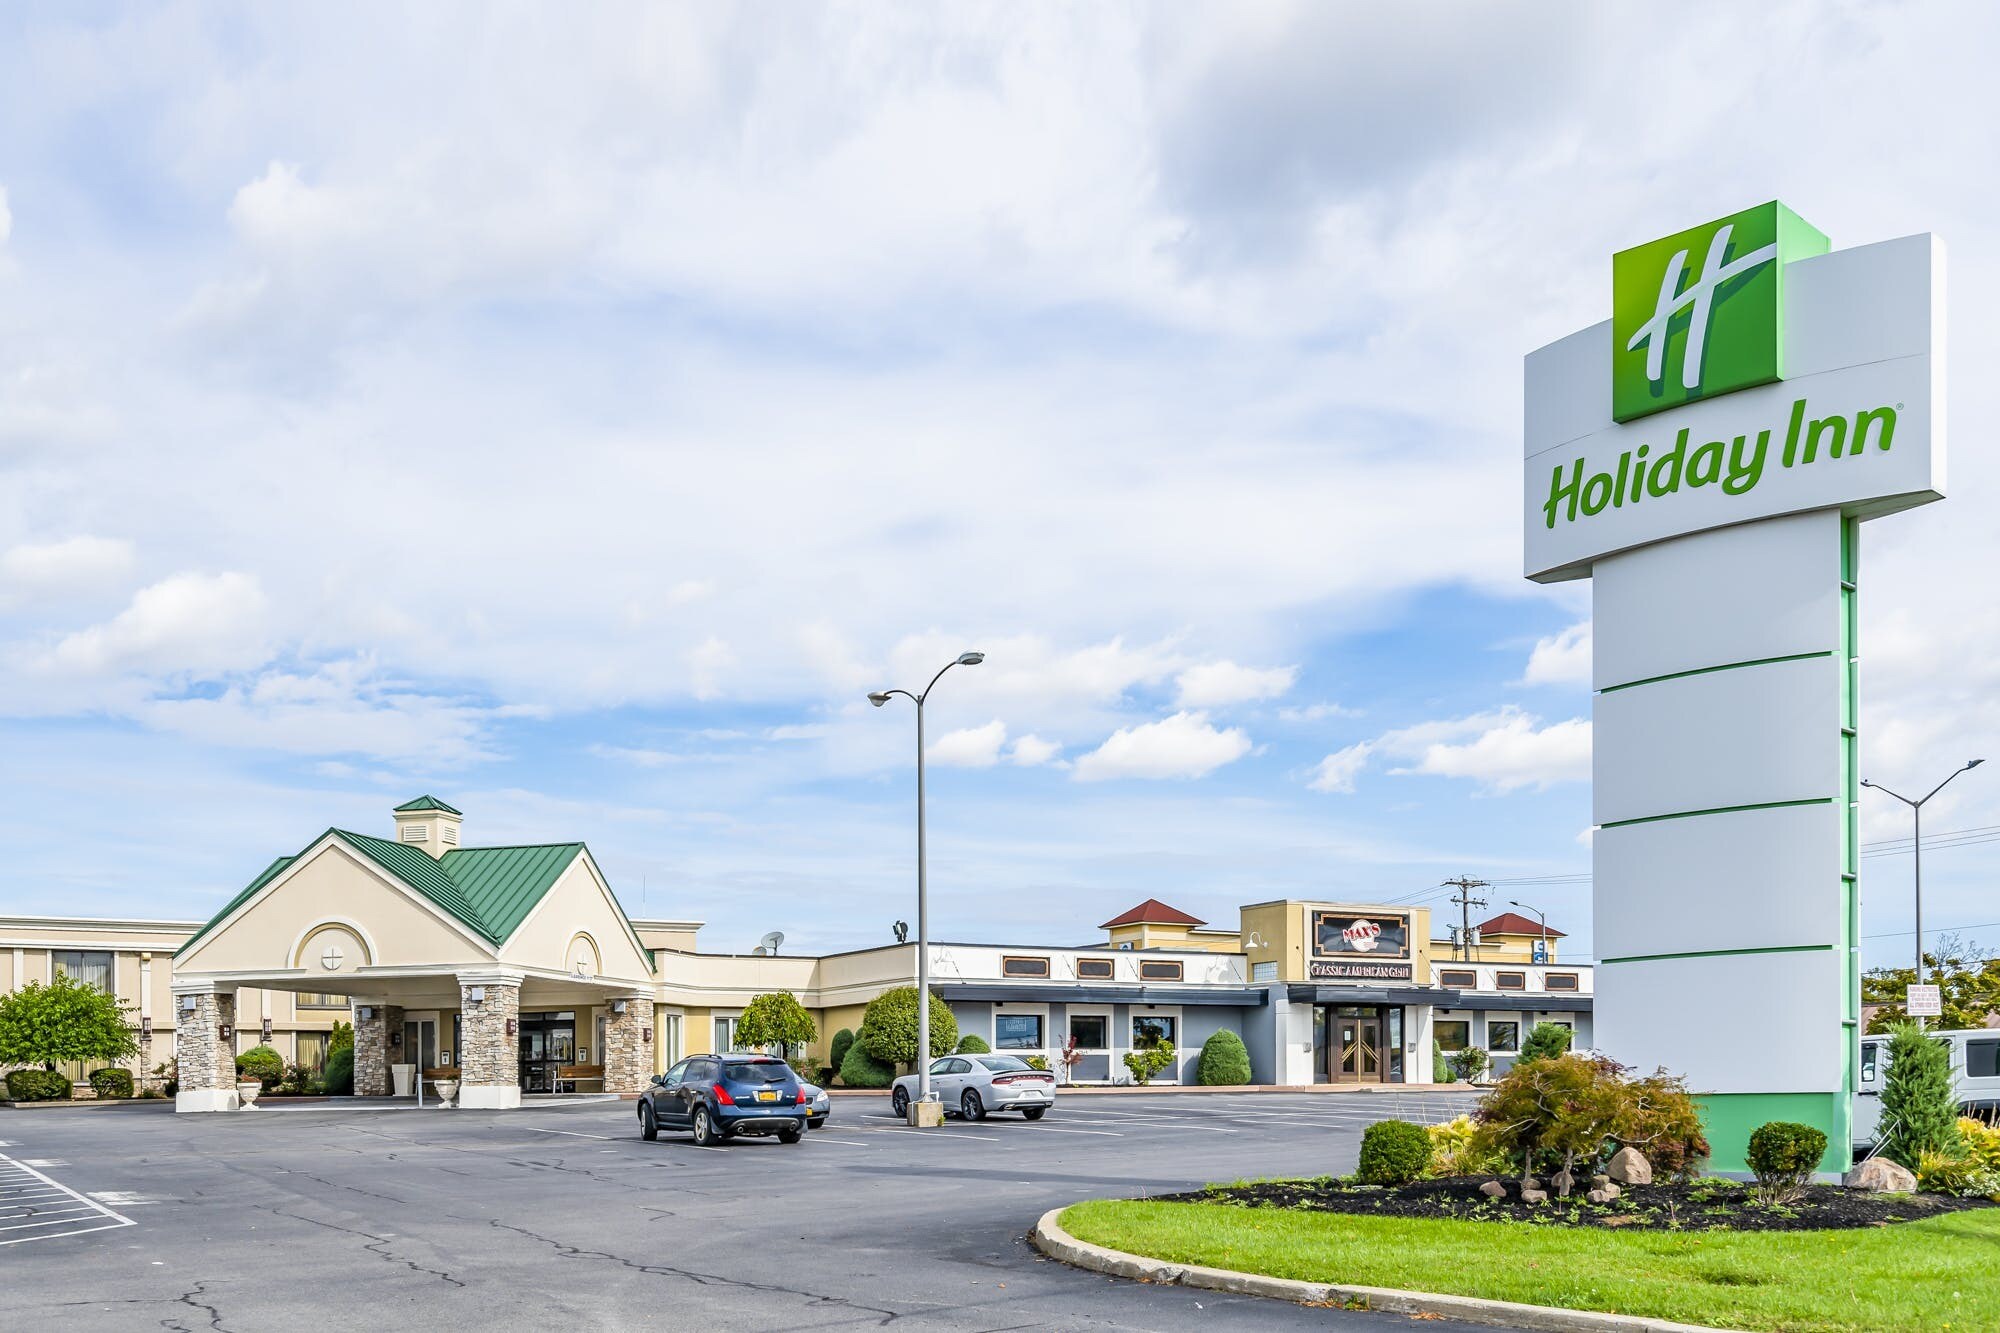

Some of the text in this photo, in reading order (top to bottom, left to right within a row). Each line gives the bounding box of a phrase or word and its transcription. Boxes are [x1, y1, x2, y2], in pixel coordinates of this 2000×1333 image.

[1627, 224, 1777, 388] H
[1543, 399, 1898, 528] Holiday Inn
